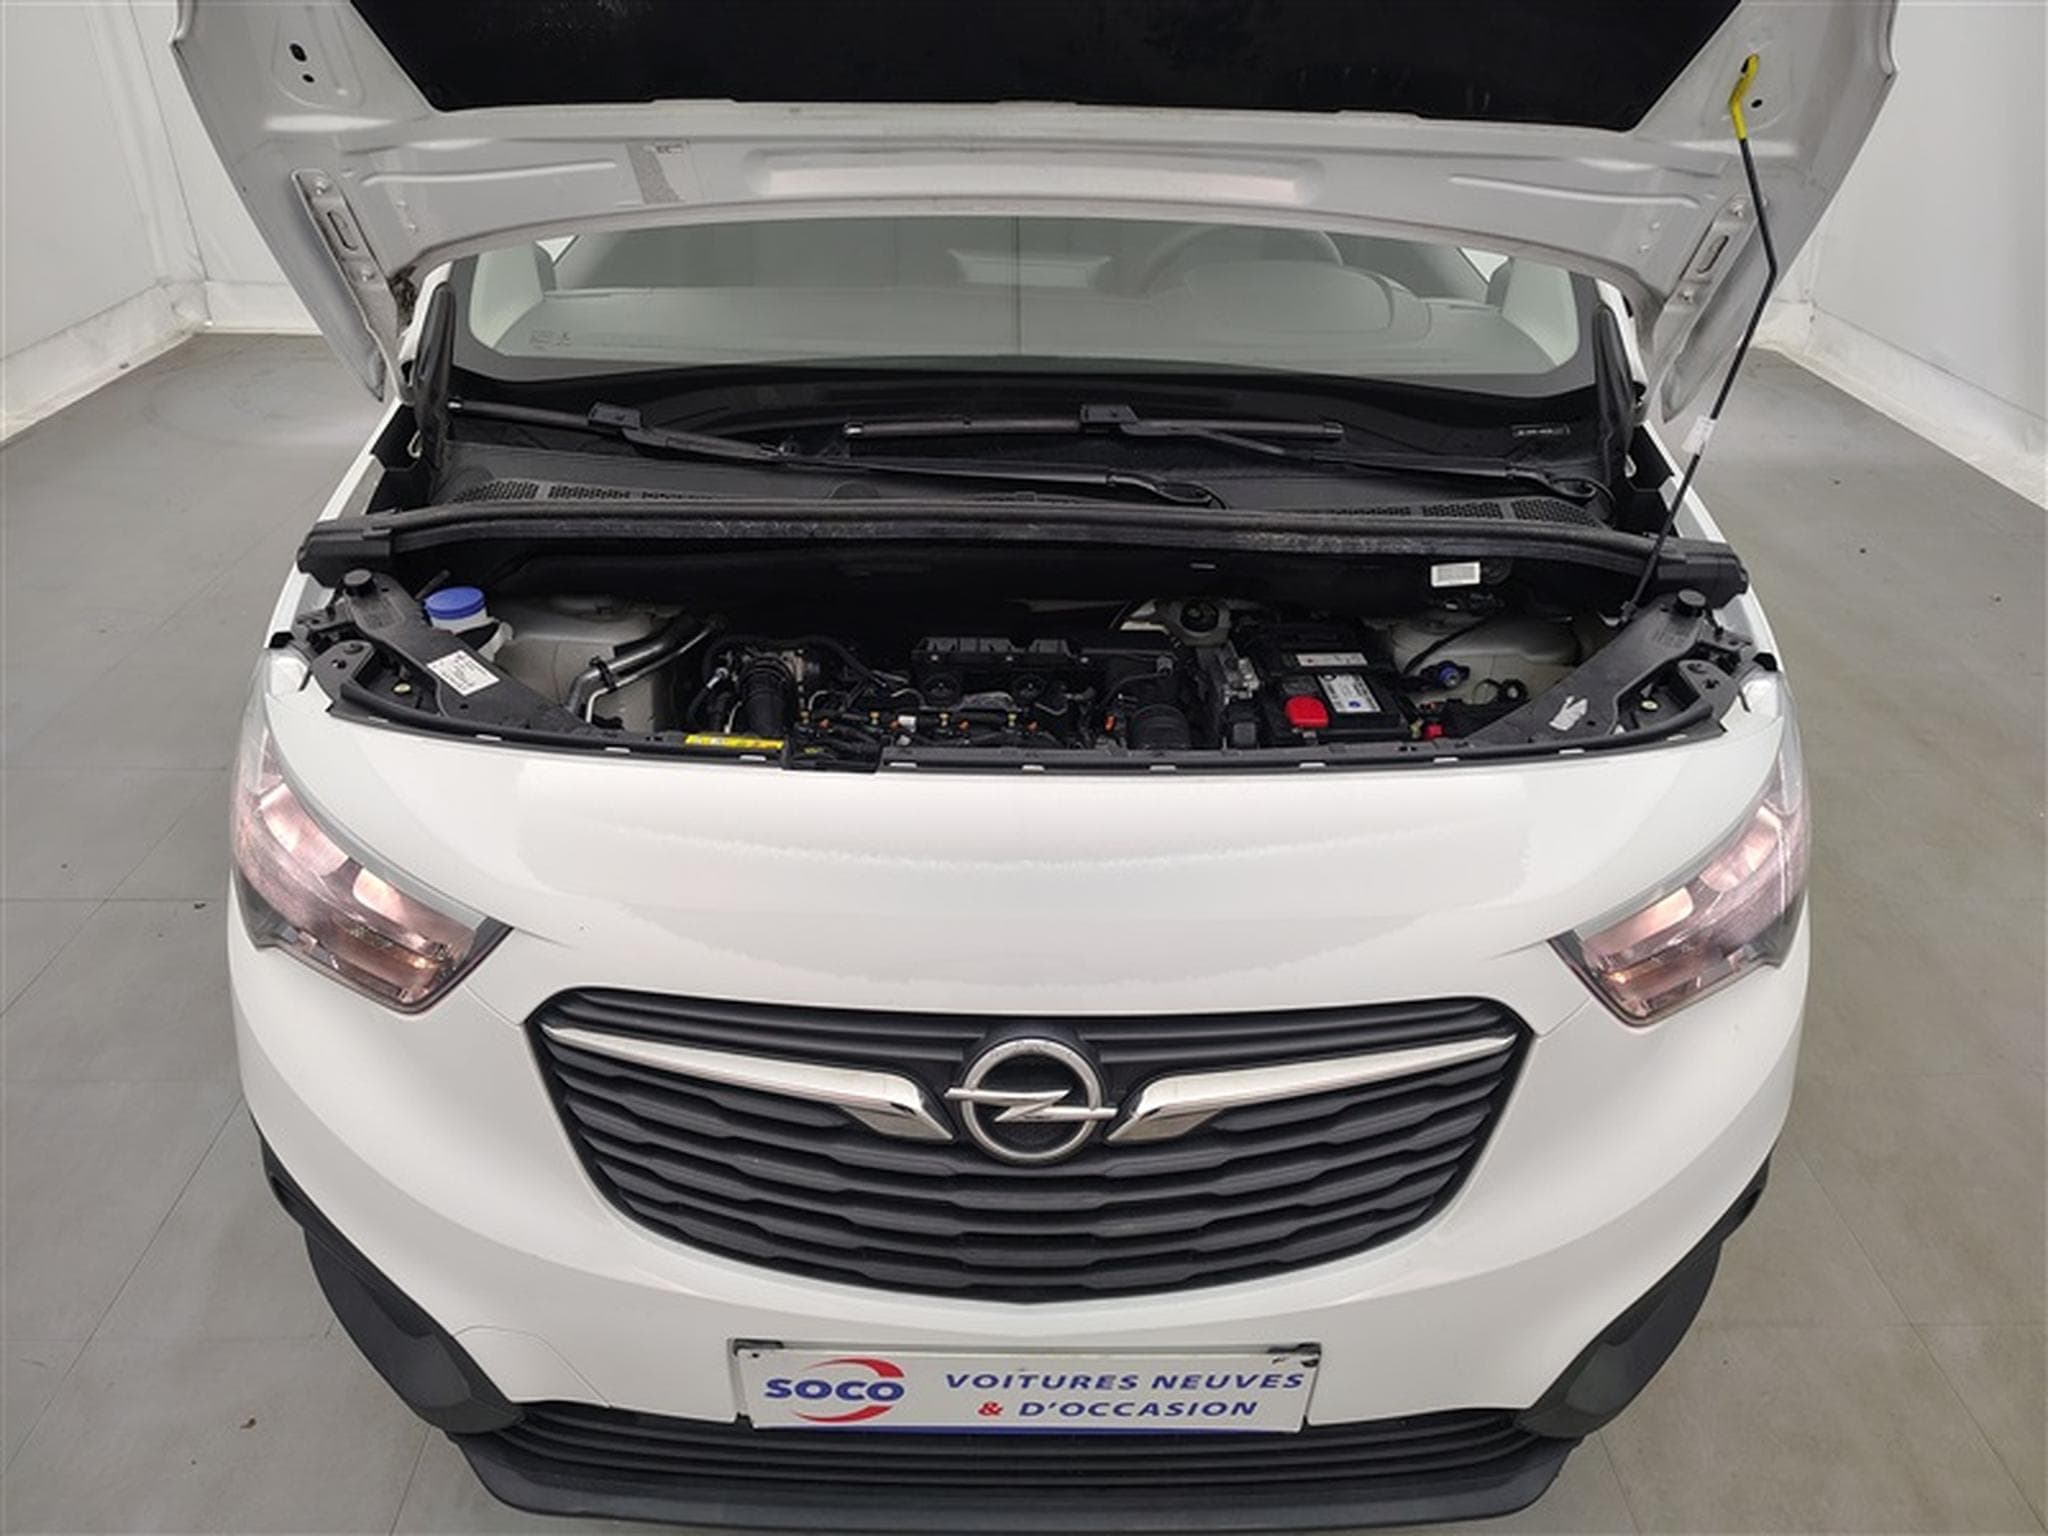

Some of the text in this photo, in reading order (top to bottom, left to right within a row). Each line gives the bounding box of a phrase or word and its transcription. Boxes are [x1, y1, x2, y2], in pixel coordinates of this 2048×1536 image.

[764, 1378, 905, 1402] SOCO
[946, 1373, 1305, 1390] VOITURES NEUVES
[977, 1401, 1258, 1417] & D'OCCASION
